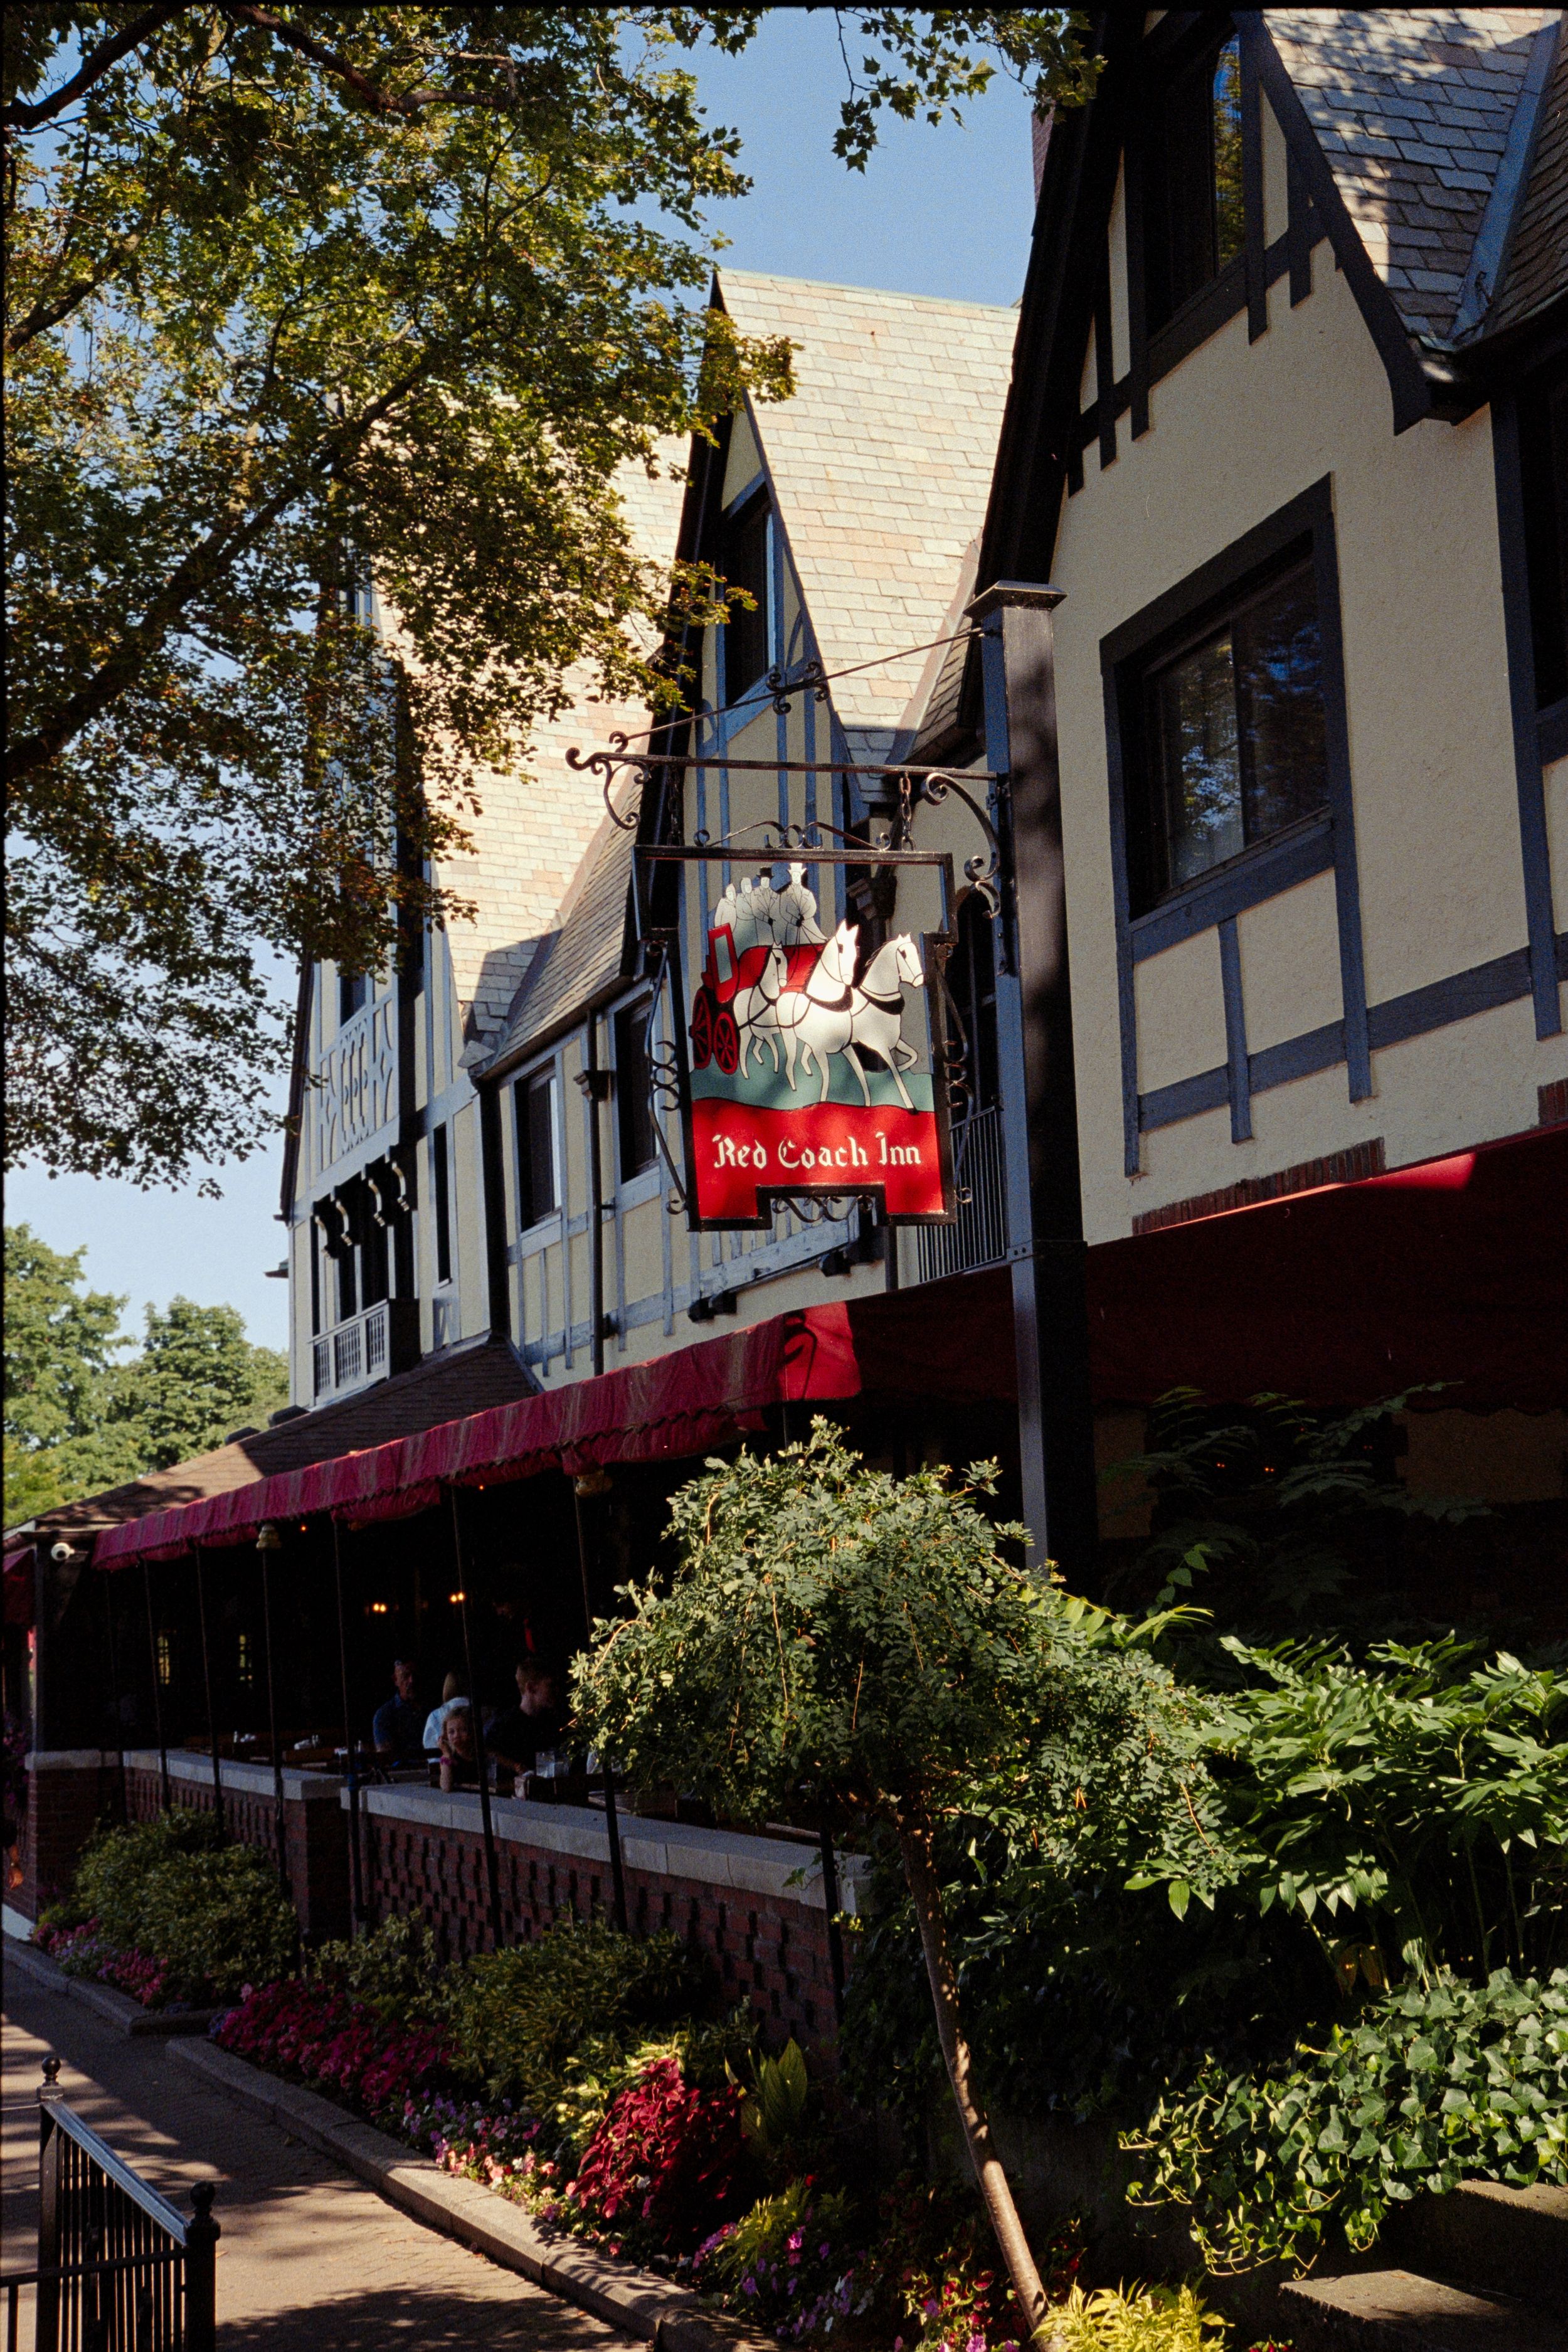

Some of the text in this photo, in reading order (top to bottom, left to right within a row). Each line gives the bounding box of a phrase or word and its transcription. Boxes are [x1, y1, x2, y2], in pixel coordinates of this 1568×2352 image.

[712, 1131, 922, 1169] Red Coach Inn
